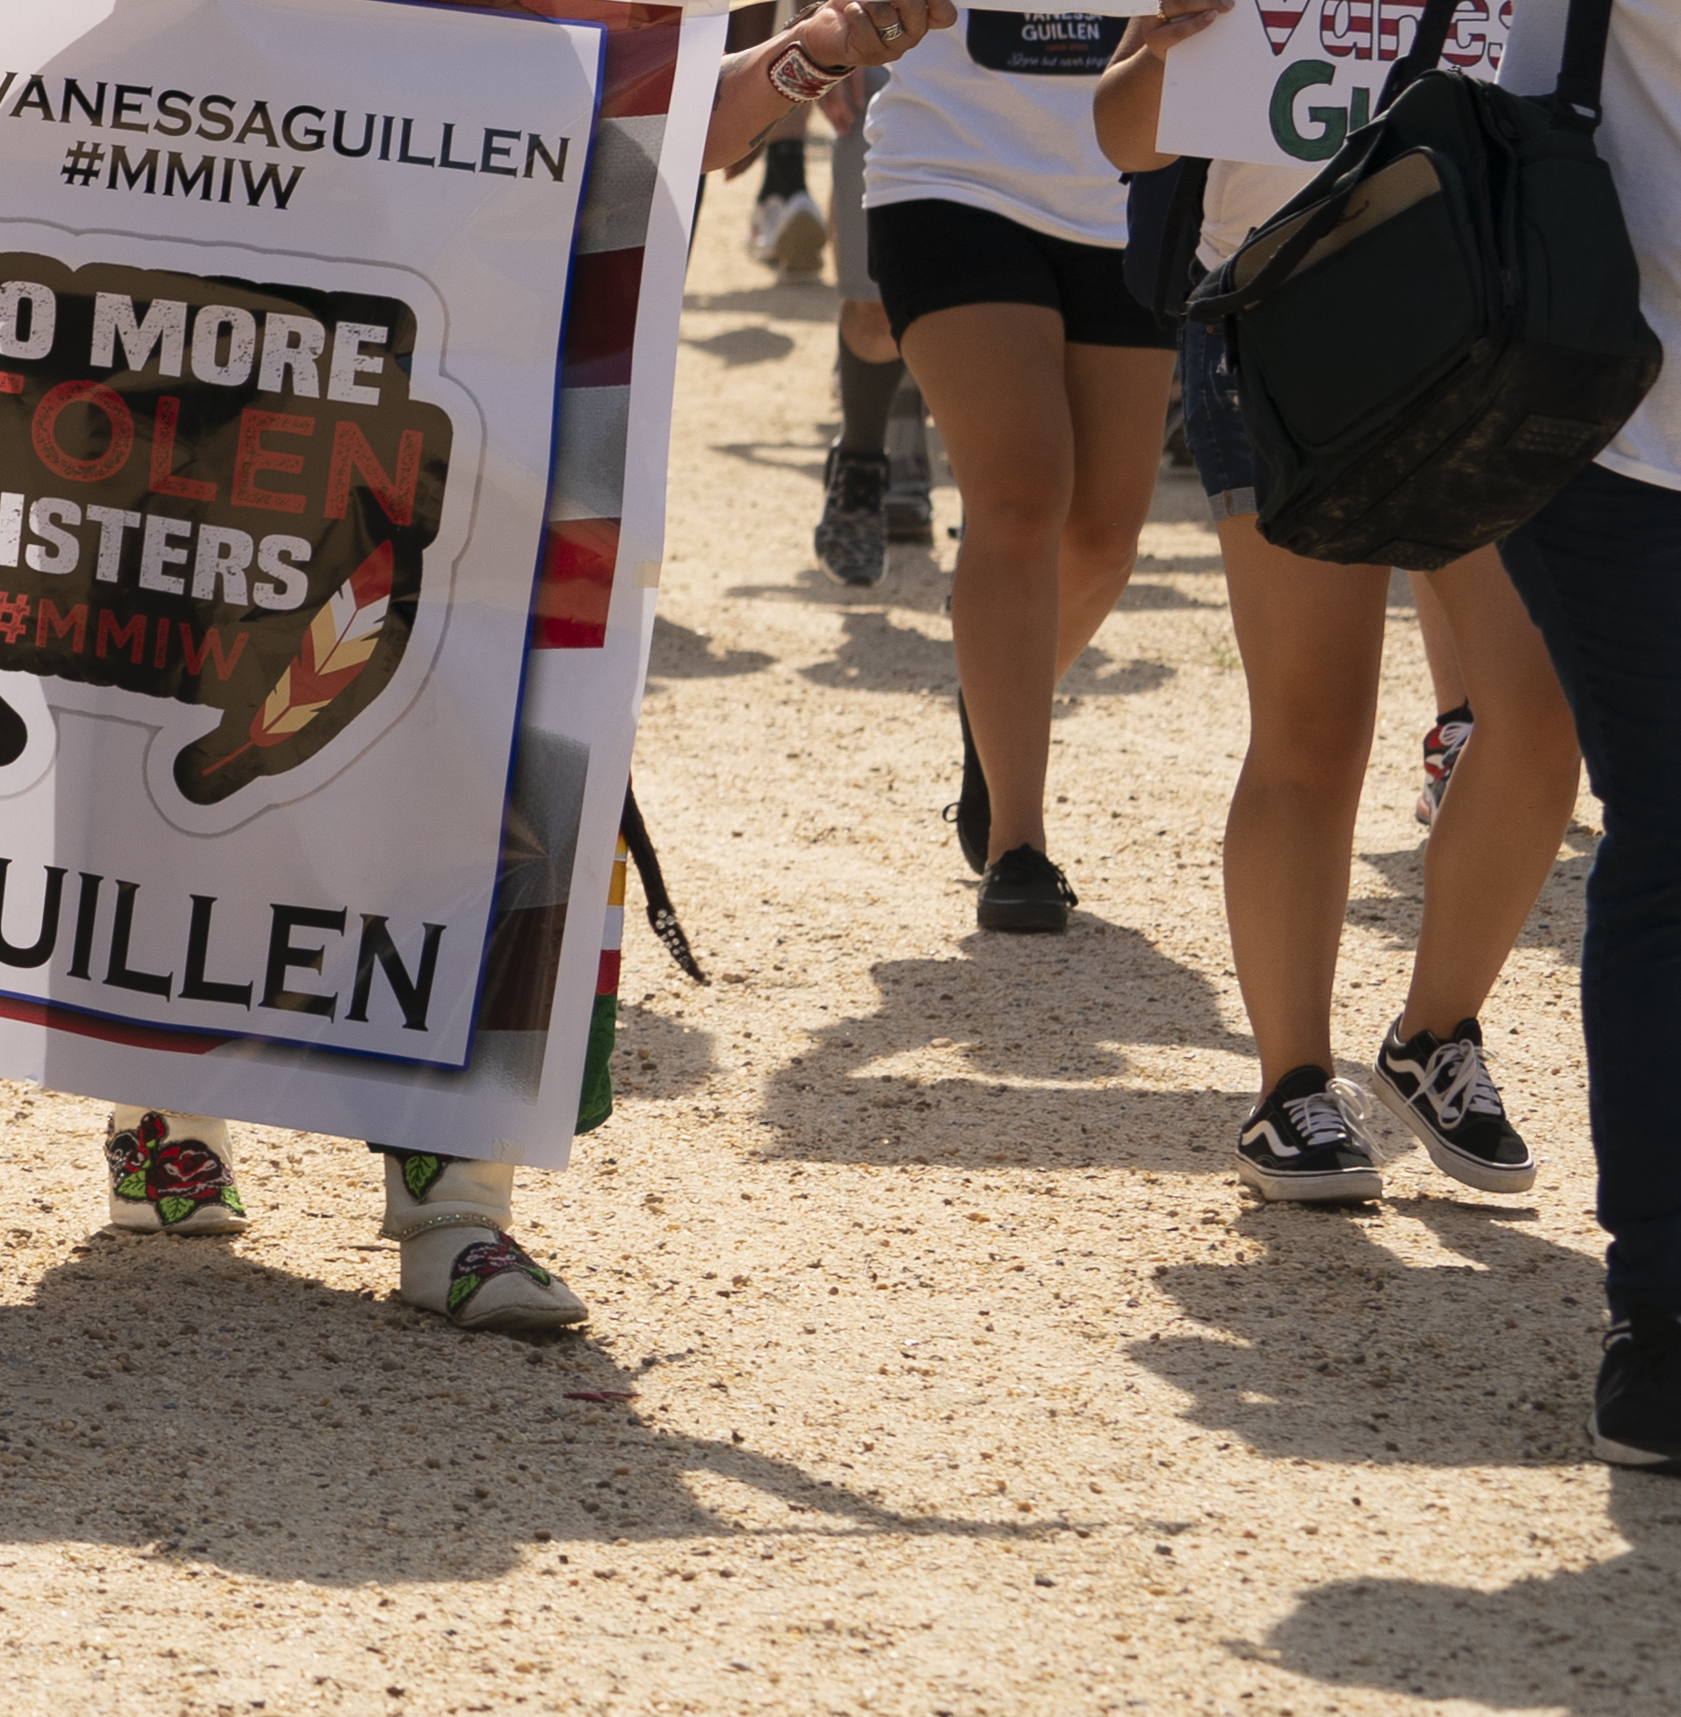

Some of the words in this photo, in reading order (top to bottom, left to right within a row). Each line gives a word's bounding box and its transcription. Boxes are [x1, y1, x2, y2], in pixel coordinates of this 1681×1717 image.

[1021, 23, 1100, 41] GUILLEN
[59, 138, 306, 211] #MMIW
[89, 289, 390, 407] MORE
